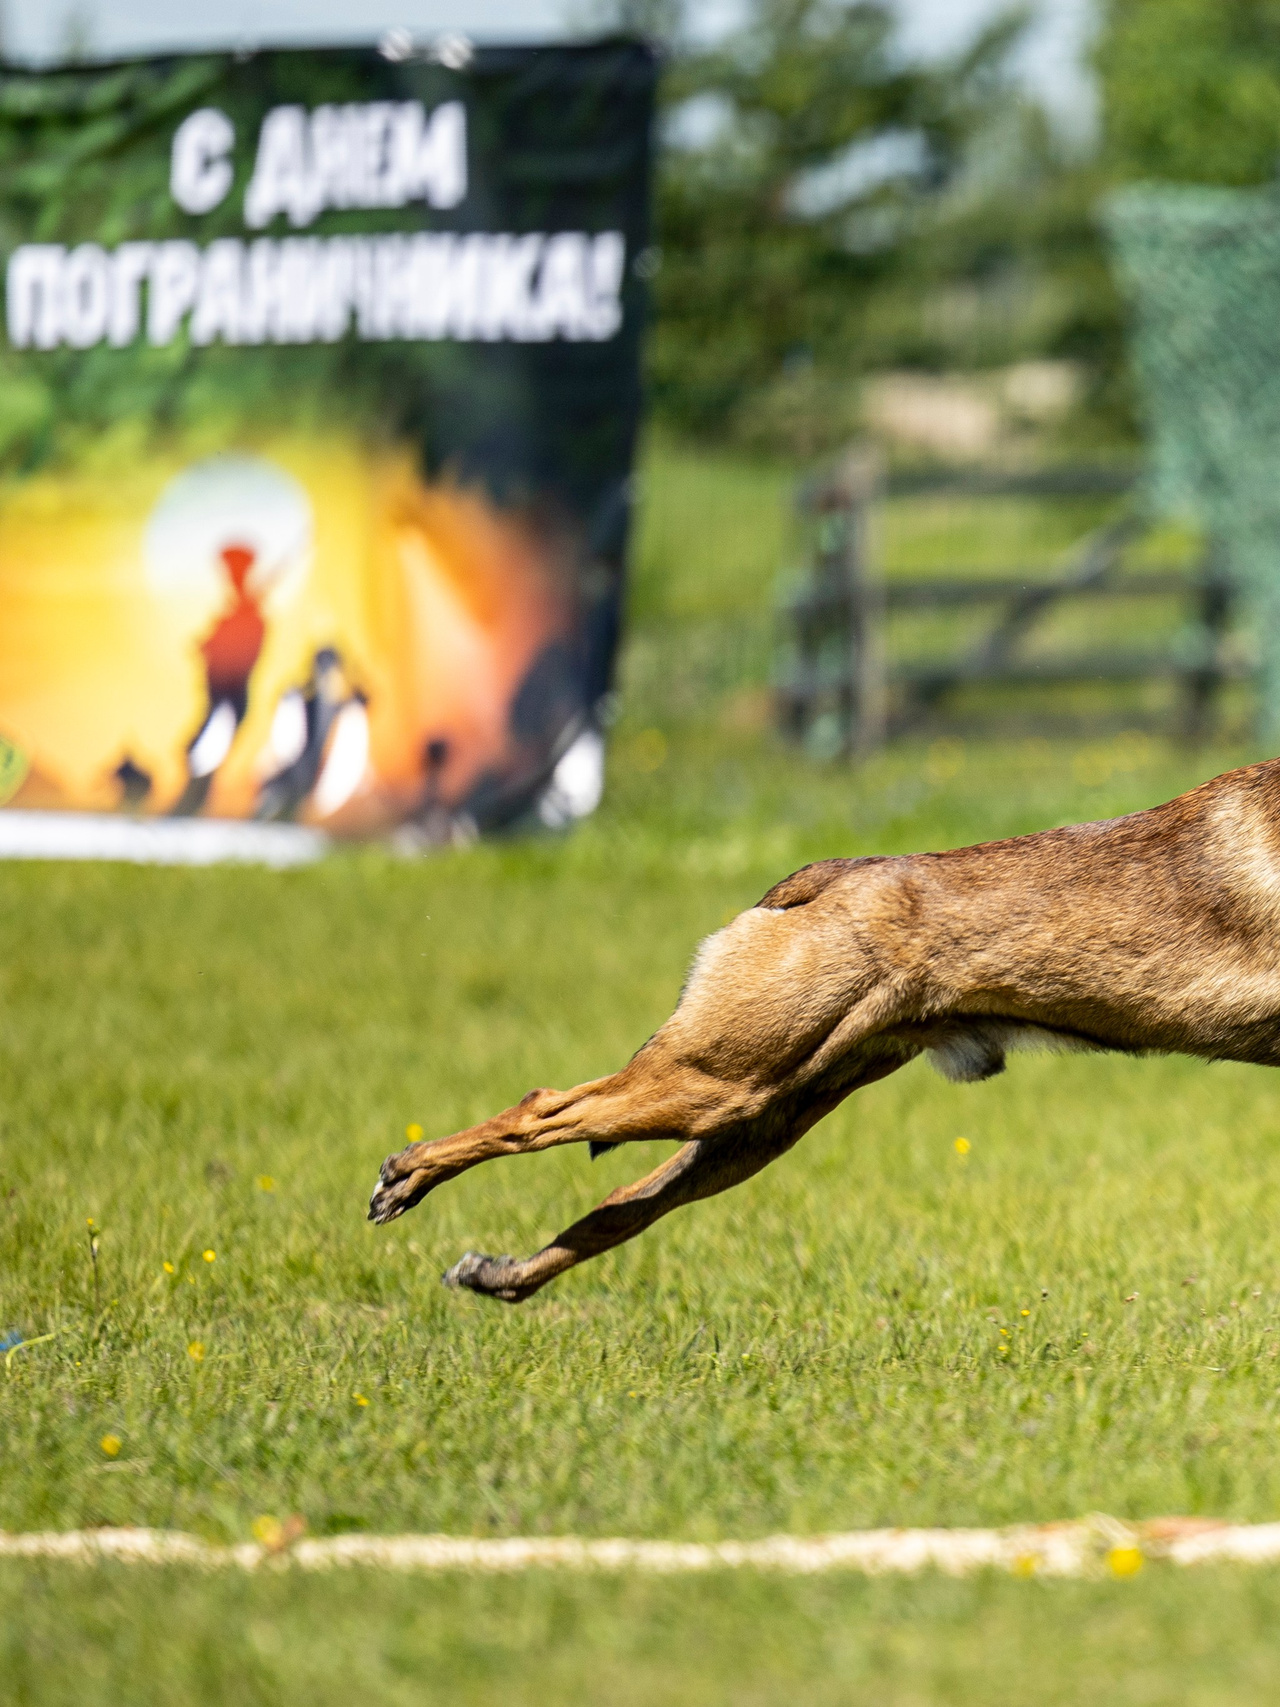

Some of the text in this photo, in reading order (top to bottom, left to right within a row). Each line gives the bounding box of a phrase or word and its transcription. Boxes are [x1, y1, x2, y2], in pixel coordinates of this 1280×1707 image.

[171, 102, 467, 227] С ДНЕМ
[8, 232, 625, 348] ПОГРАНИЧНИКА!
